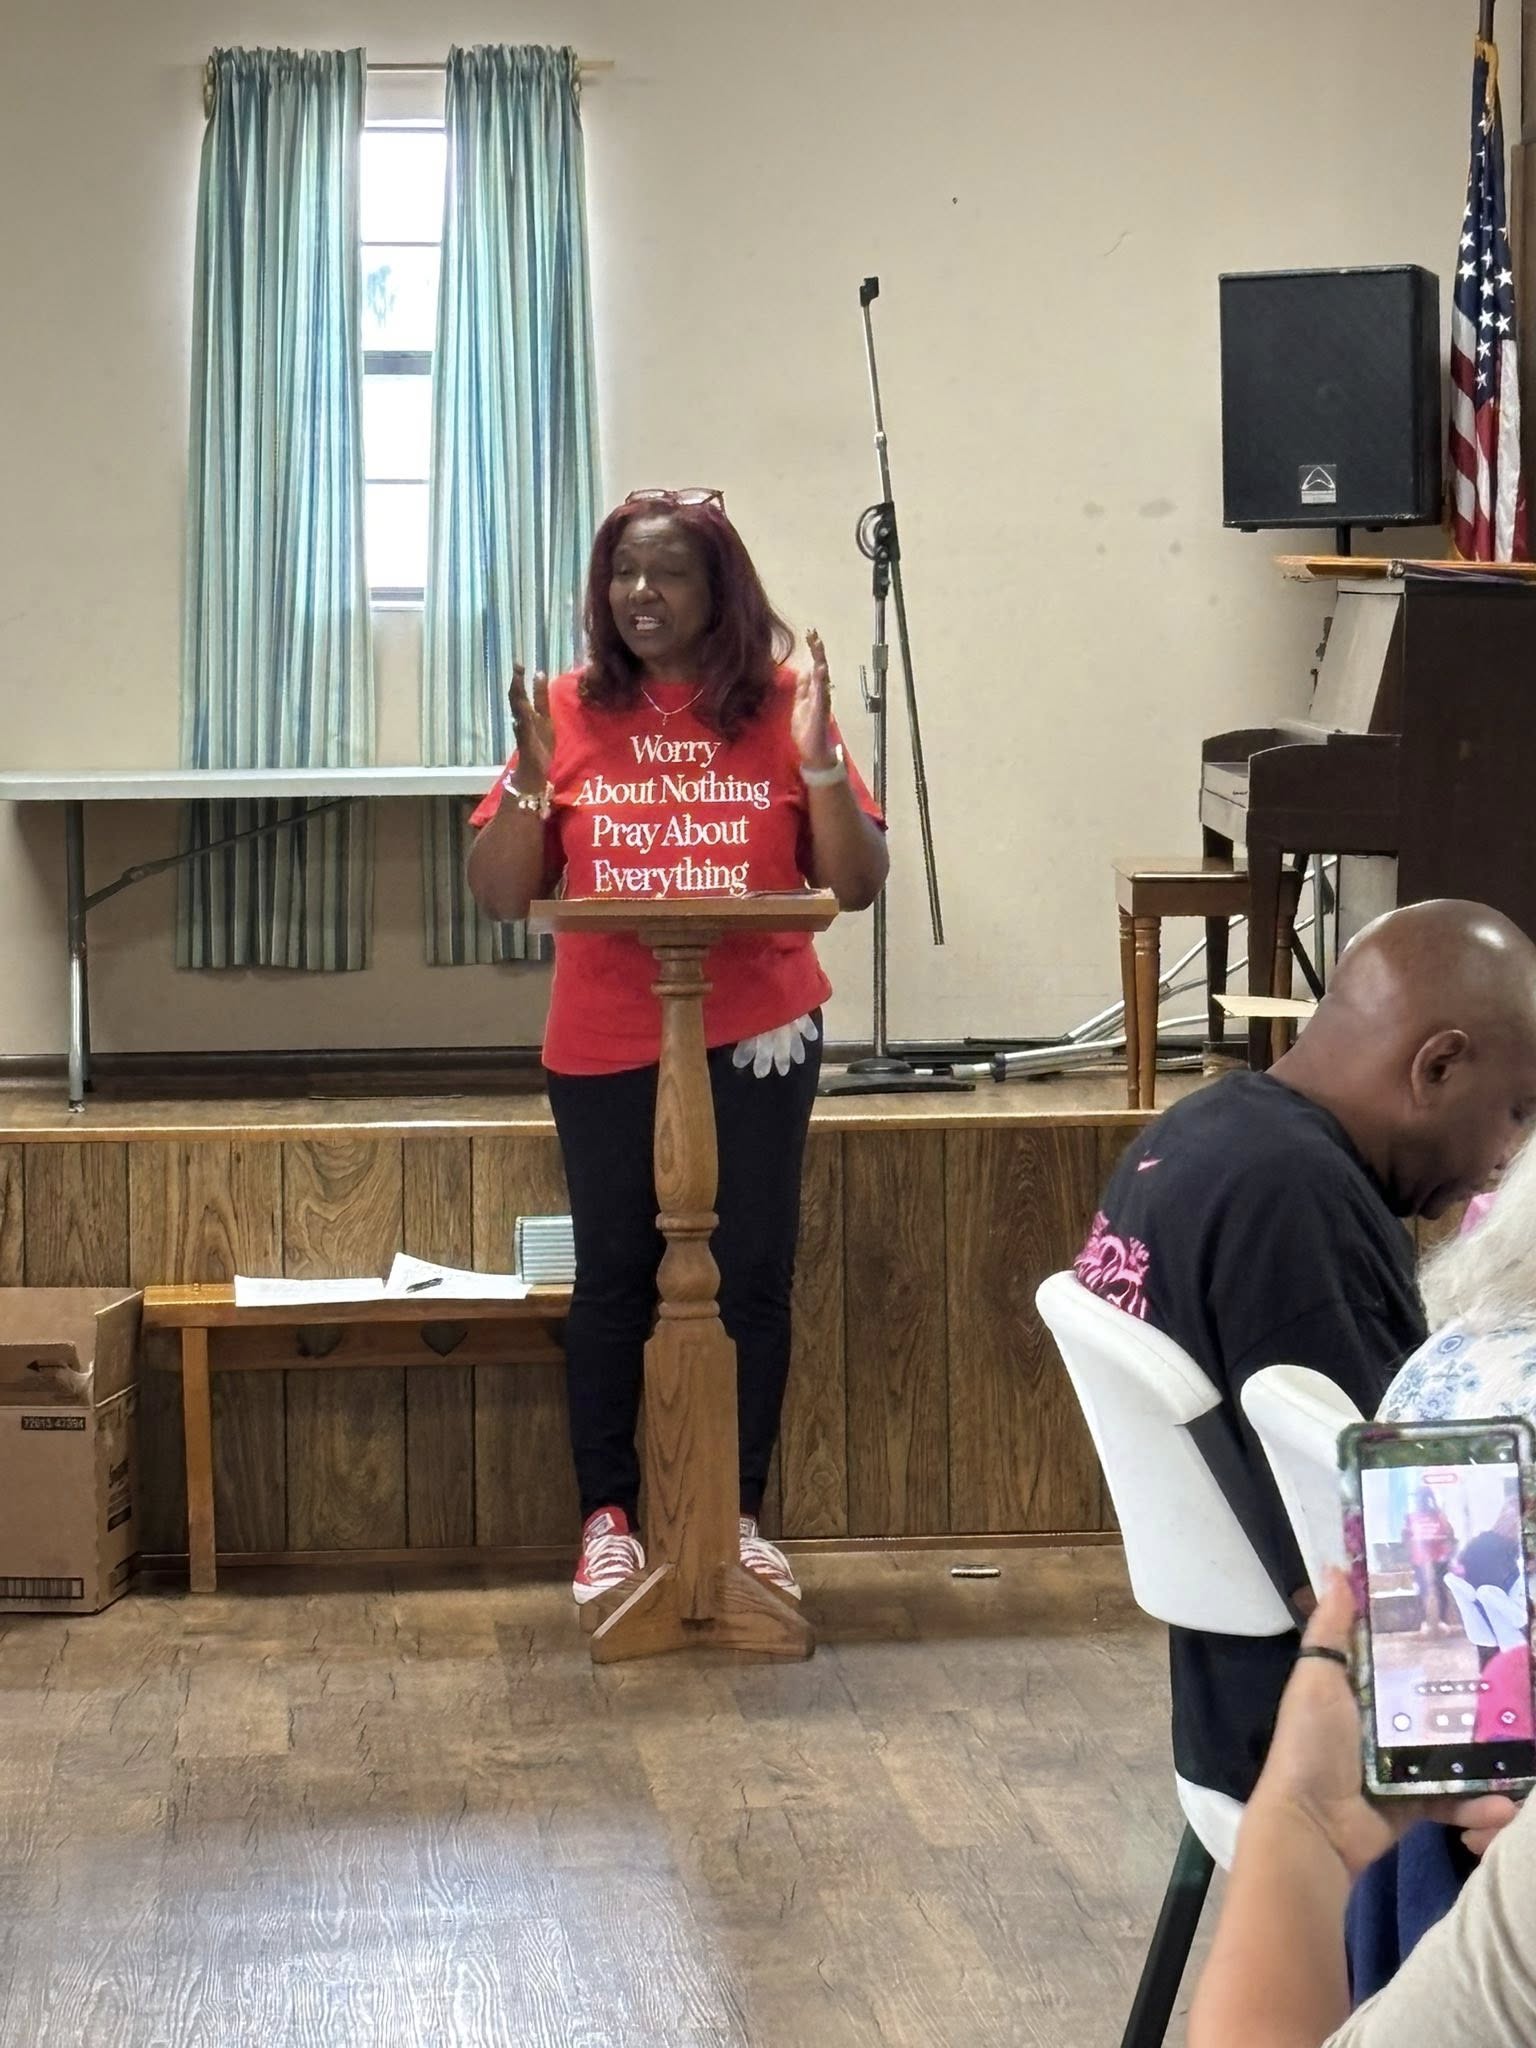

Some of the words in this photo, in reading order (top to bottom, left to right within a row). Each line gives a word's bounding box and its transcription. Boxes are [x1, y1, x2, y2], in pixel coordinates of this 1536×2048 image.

[630, 734, 721, 768] Worry
[572, 774, 657, 806] About
[659, 770, 771, 810] Nothing
[592, 814, 661, 854] Pray
[661, 812, 750, 847] About
[592, 856, 750, 898] Everything
